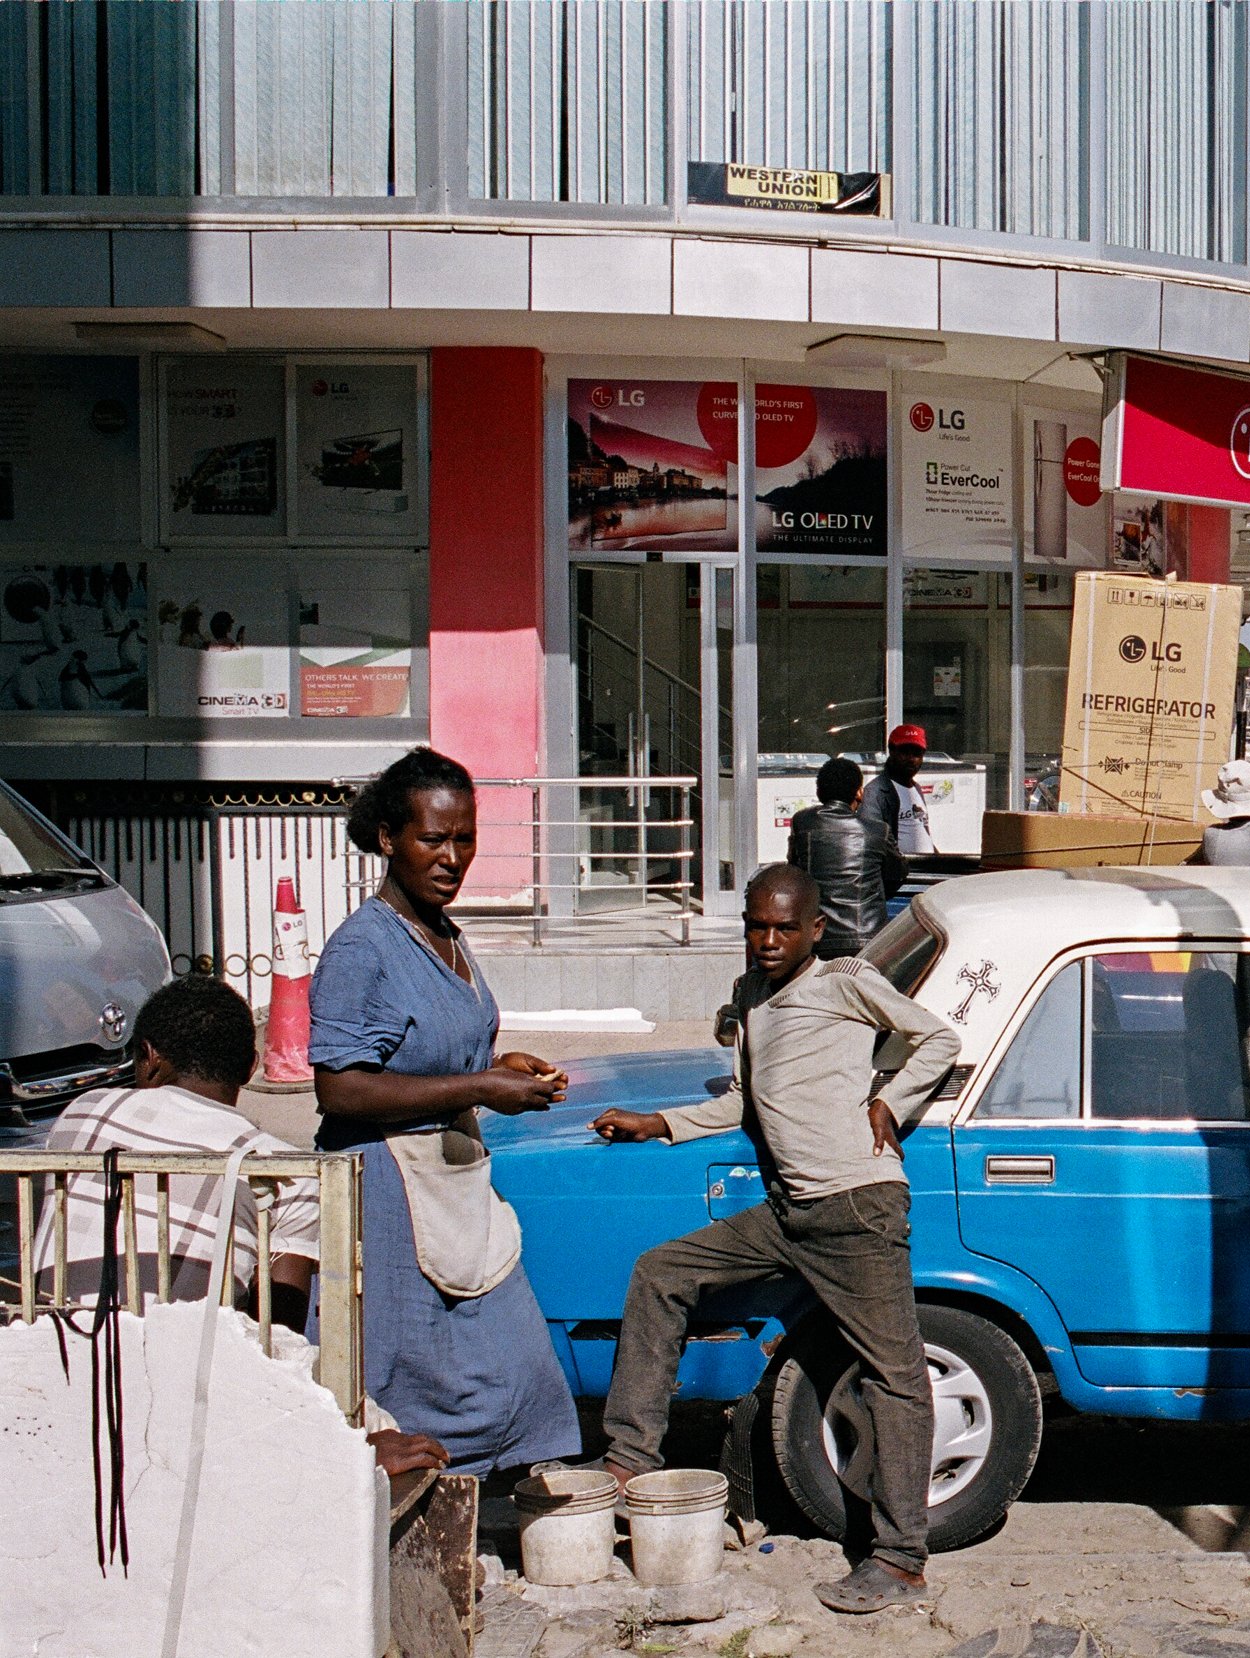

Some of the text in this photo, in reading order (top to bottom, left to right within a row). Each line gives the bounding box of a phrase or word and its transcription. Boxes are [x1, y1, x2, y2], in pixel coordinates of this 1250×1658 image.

[730, 166, 818, 186] WESTERN
[757, 182, 818, 198] UNION
[195, 389, 238, 399] SMART
[331, 383, 349, 394] LG
[618, 390, 645, 407] LG
[713, 397, 728, 405] THE
[783, 401, 804, 409] FIRST
[762, 413, 783, 422] OLED
[784, 414, 795, 422] TV
[939, 408, 966, 431] LG
[1068, 457, 1086, 467] Power
[941, 472, 1000, 489] EverCool
[1068, 472, 1093, 482] EverCool
[772, 511, 874, 530] LG OLED TV
[773, 534, 874, 544] THE ULTIMATE DISPLAY
[1151, 641, 1182, 663] LG
[1168, 666, 1187, 674] Good
[305, 673, 337, 682] OTHERS
[362, 673, 376, 681] WE
[197, 693, 287, 710] CINEMA 3D
[1081, 692, 1216, 720] REFRIGERATOR
[1129, 791, 1162, 800] CAUTION
